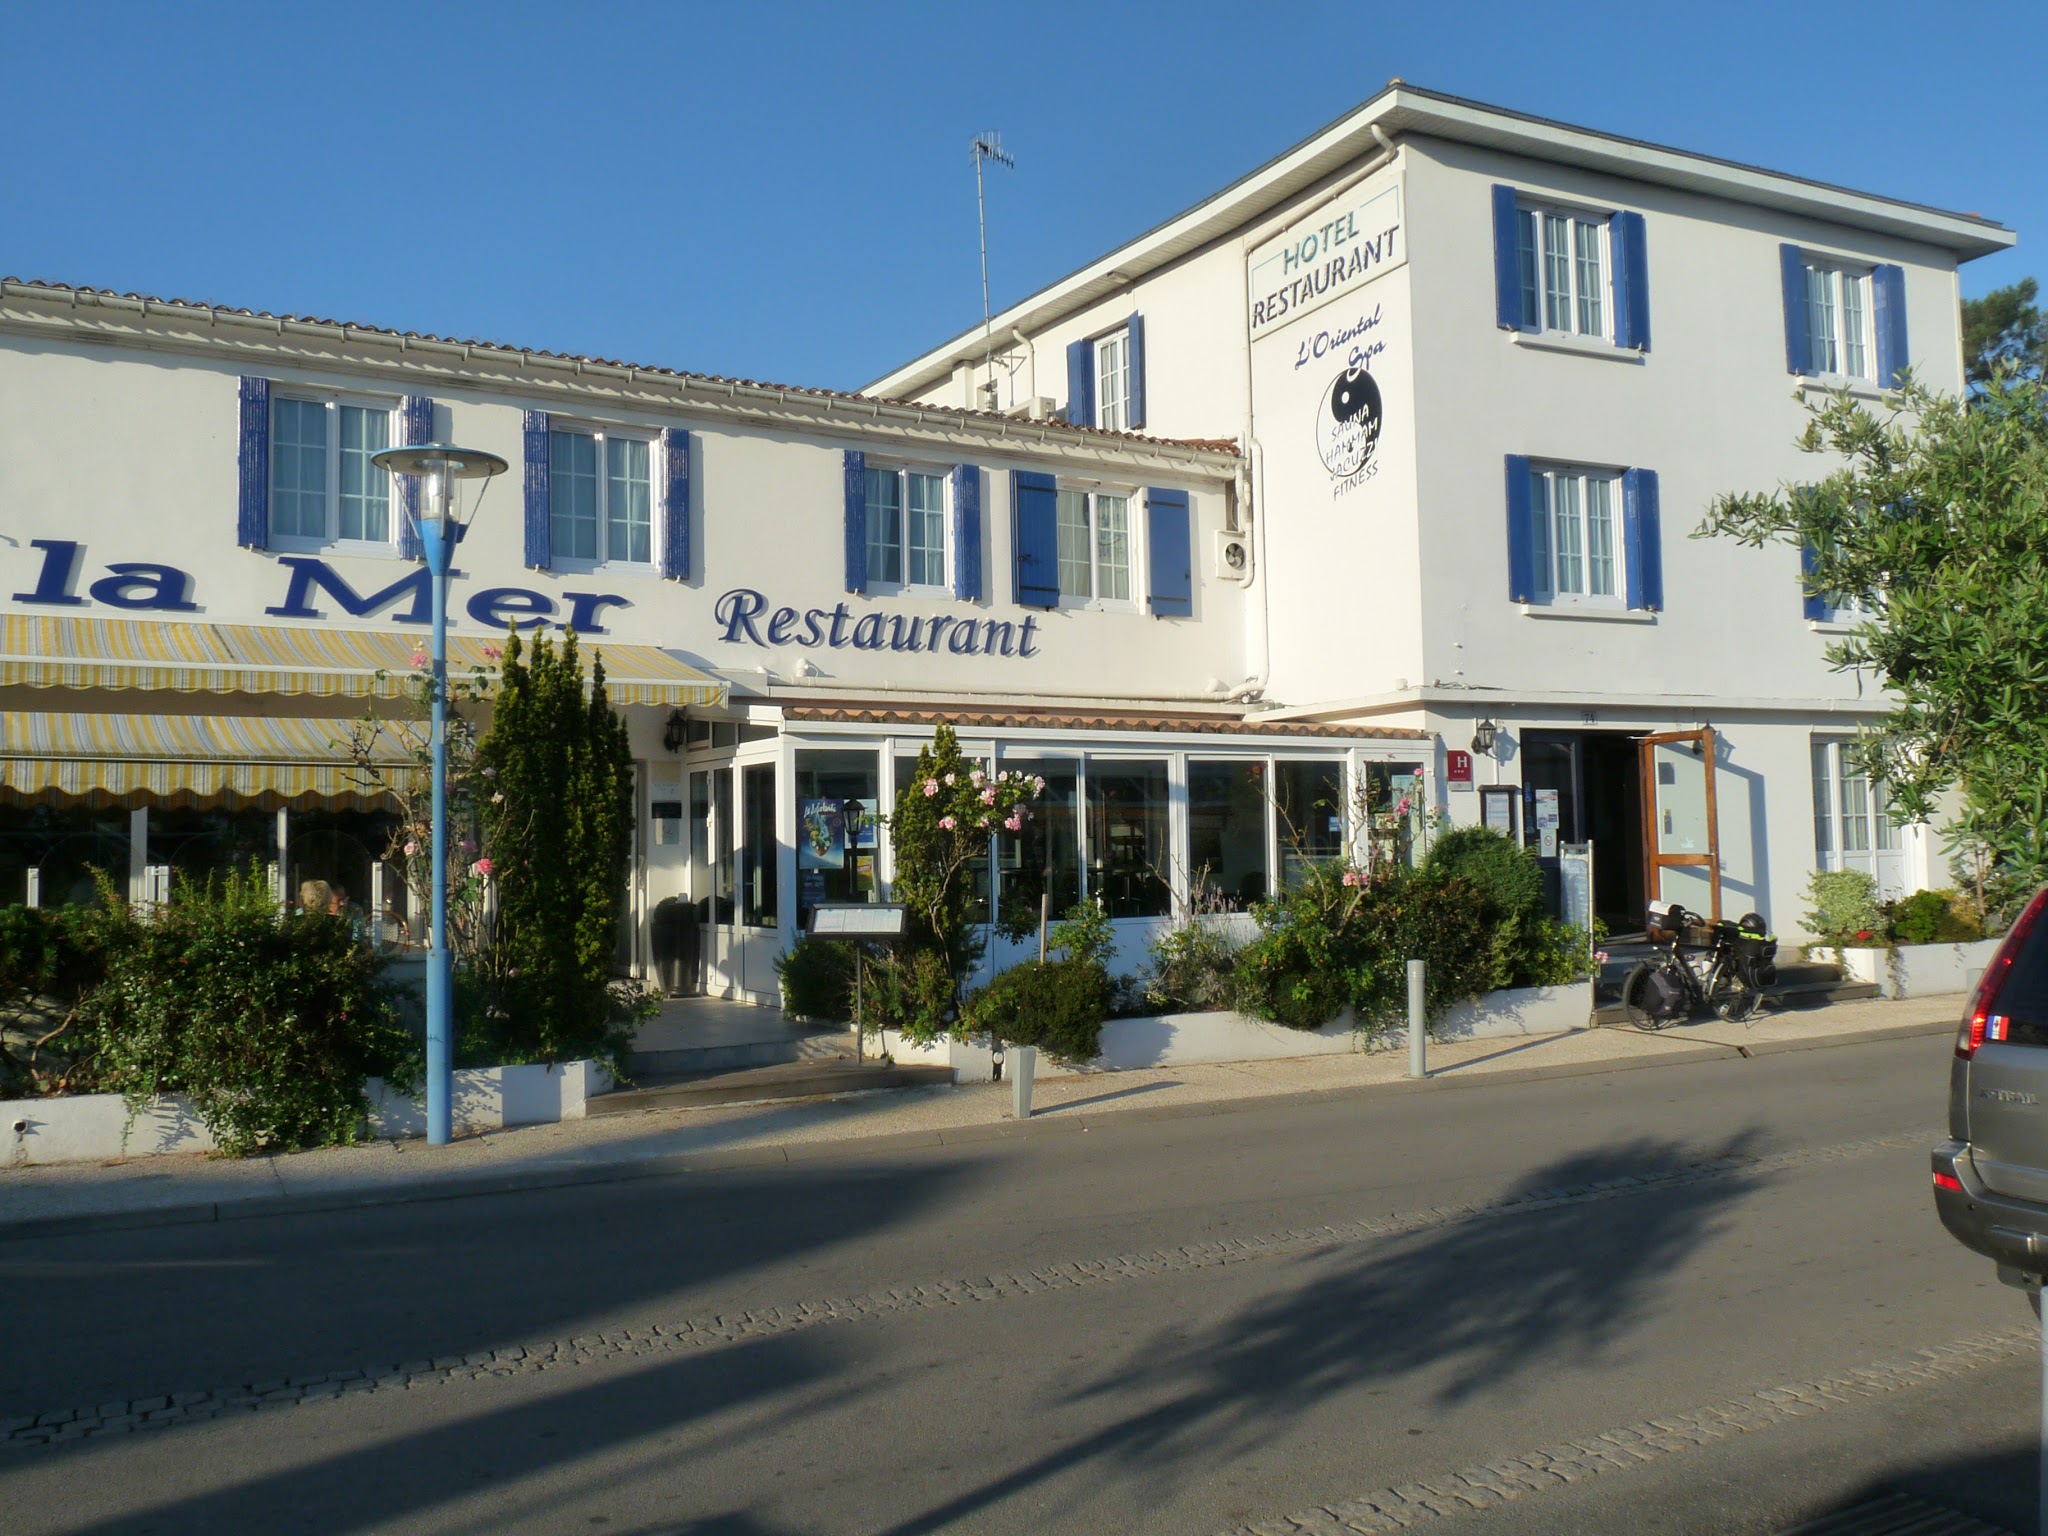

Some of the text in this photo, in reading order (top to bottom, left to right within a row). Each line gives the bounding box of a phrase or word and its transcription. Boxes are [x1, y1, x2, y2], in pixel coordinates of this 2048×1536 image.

[1283, 210, 1360, 276] HOTEL
[1252, 224, 1400, 329] RESTAURANT
[1294, 302, 1384, 371] L'Oriental
[1346, 340, 1387, 382] Spa
[1326, 416, 1378, 464] HAMMAM
[1331, 403, 1370, 442] SAUNA
[1330, 437, 1378, 482] JACUZZI
[1333, 460, 1378, 502] FITNESS
[12, 538, 632, 634] la Mer
[714, 588, 1040, 658] Restaurant
[1457, 756, 1468, 768] H
